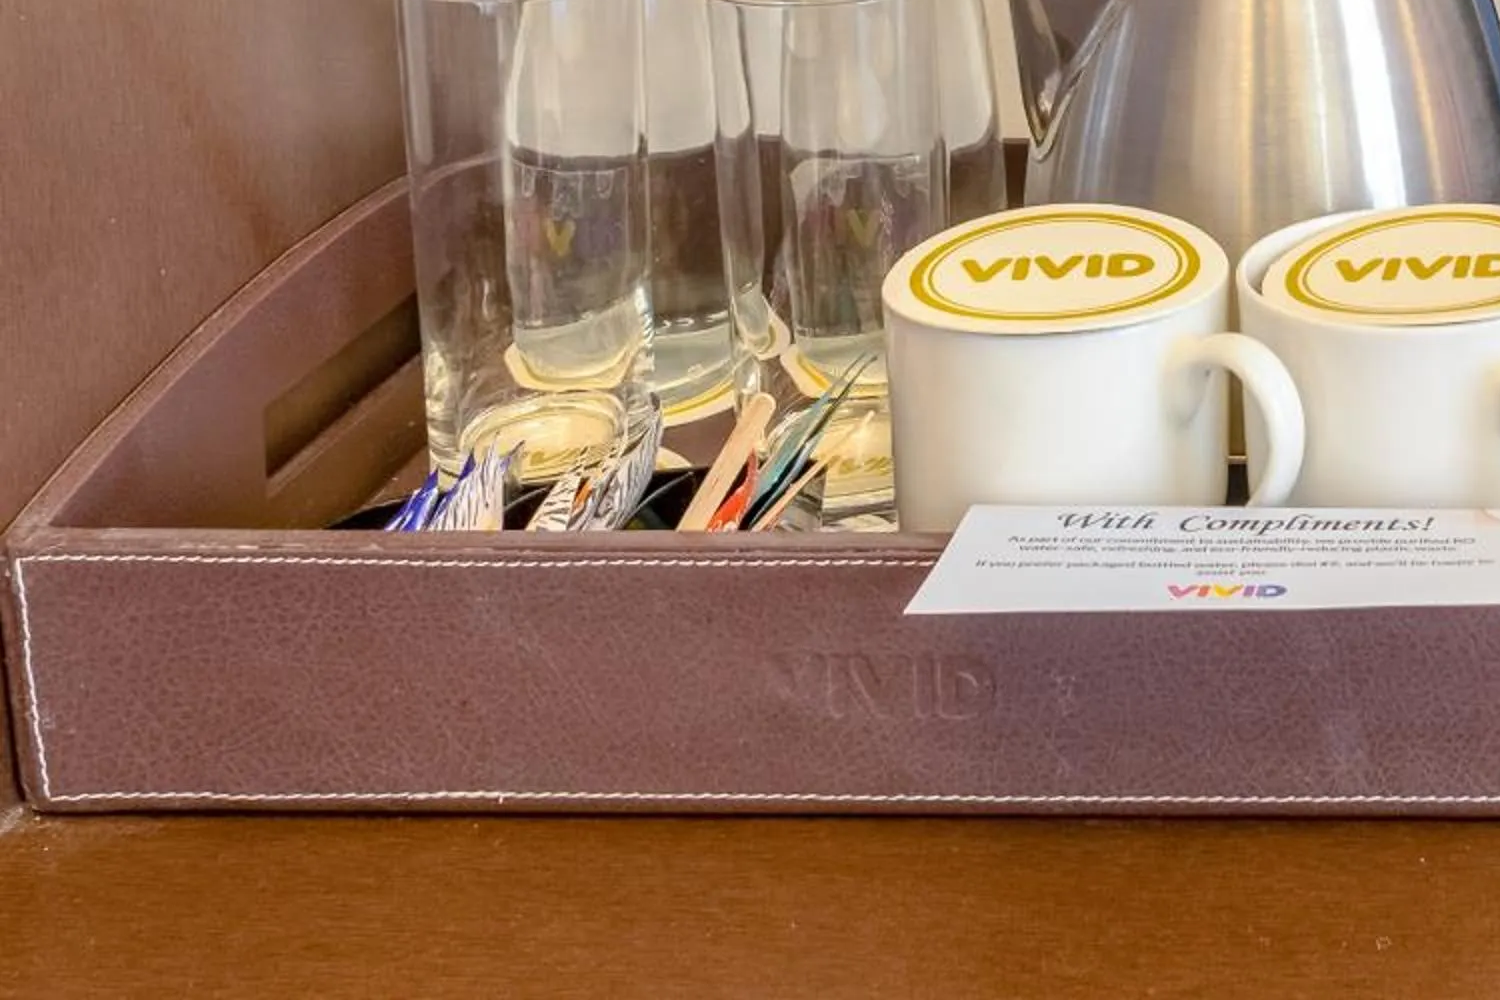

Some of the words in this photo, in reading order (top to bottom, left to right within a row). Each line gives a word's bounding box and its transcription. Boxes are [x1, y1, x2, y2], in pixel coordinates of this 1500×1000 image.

[961, 253, 1156, 283] VIVID
[1057, 511, 1158, 530] With
[1179, 513, 1435, 536] Compliments!
[1167, 583, 1288, 599] VIVID
